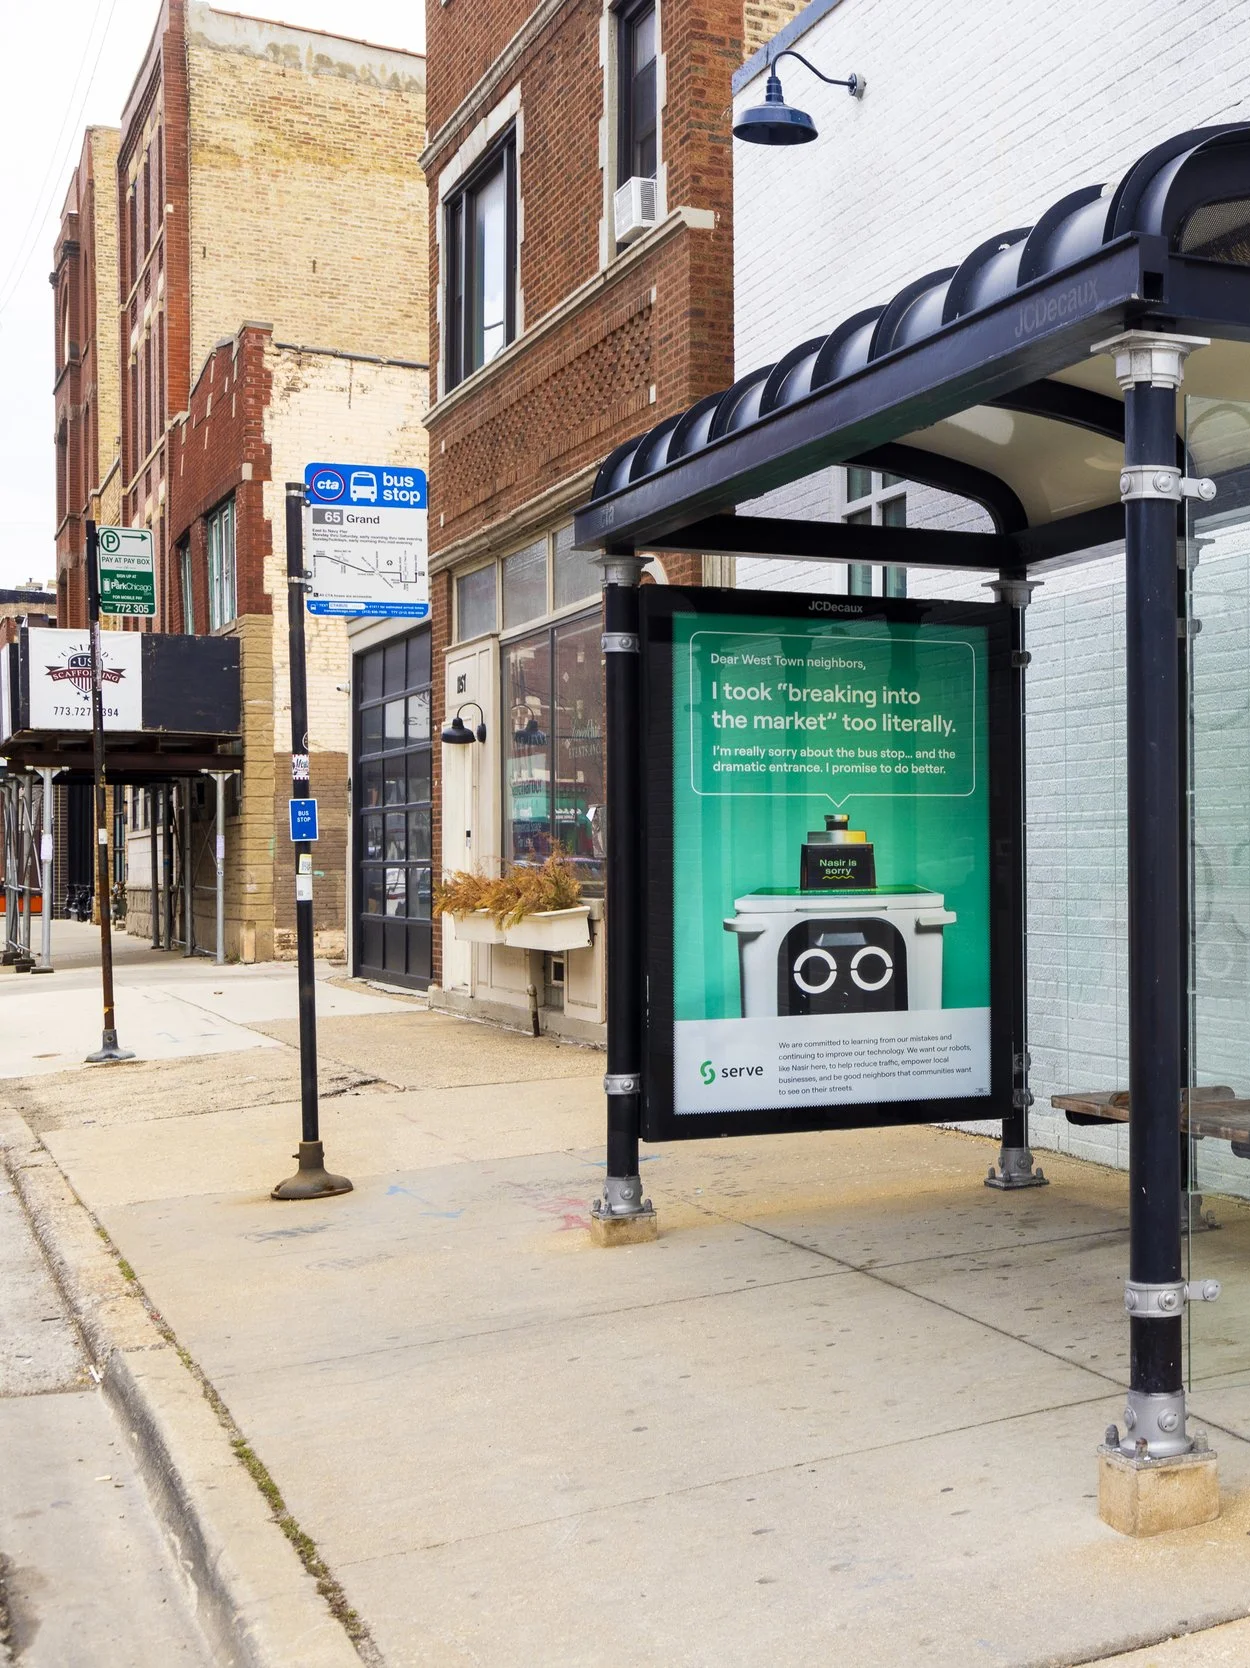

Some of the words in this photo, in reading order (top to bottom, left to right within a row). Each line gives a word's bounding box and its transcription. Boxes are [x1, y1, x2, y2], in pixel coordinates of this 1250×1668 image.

[1014, 278, 1099, 338] JCDecaux
[317, 479, 339, 490] cta
[382, 472, 415, 487] bus
[382, 488, 421, 505] stop
[324, 511, 341, 523] 65
[346, 514, 380, 524] Grand
[111, 581, 151, 592] ParkChicago
[116, 604, 132, 613] 772
[134, 605, 149, 613] 305
[808, 601, 863, 613] JCDecaux
[61, 643, 109, 658] UNITD
[710, 653, 738, 665] Dear
[742, 654, 772, 666] West
[774, 655, 804, 667] Town
[807, 657, 866, 670] neighbors,
[53, 669, 119, 682] SCAFFOING
[712, 681, 717, 700] I
[722, 682, 773, 701] took
[777, 683, 877, 708] “breaking
[882, 686, 921, 704] into
[53, 706, 119, 717] 773.727394
[711, 710, 748, 729] the
[753, 711, 837, 730] market”
[842, 714, 877, 731] too
[882, 713, 956, 737] literally.
[713, 745, 732, 756] I’m
[734, 745, 766, 759] really
[768, 748, 798, 759] sorry
[800, 746, 834, 758] about
[836, 747, 855, 758] the
[857, 747, 878, 758] bus
[880, 748, 913, 761] stop...
[915, 748, 936, 759] and
[938, 749, 956, 759] the
[712, 760, 766, 772] dramatic
[769, 762, 823, 773] entrance.
[826, 762, 829, 772] I
[832, 763, 878, 775] promise
[880, 764, 892, 773] to
[894, 763, 909, 774] do
[911, 763, 946, 774] better.
[819, 859, 846, 867] Nasir
[825, 867, 852, 876] sorry
[804, 1040, 840, 1048] committed
[826, 1051, 853, 1059] improve
[901, 1058, 932, 1066] empower
[721, 1065, 764, 1078] serve
[844, 1073, 861, 1081] good
[863, 1070, 896, 1079] neighbors
[912, 1068, 954, 1076] communities
